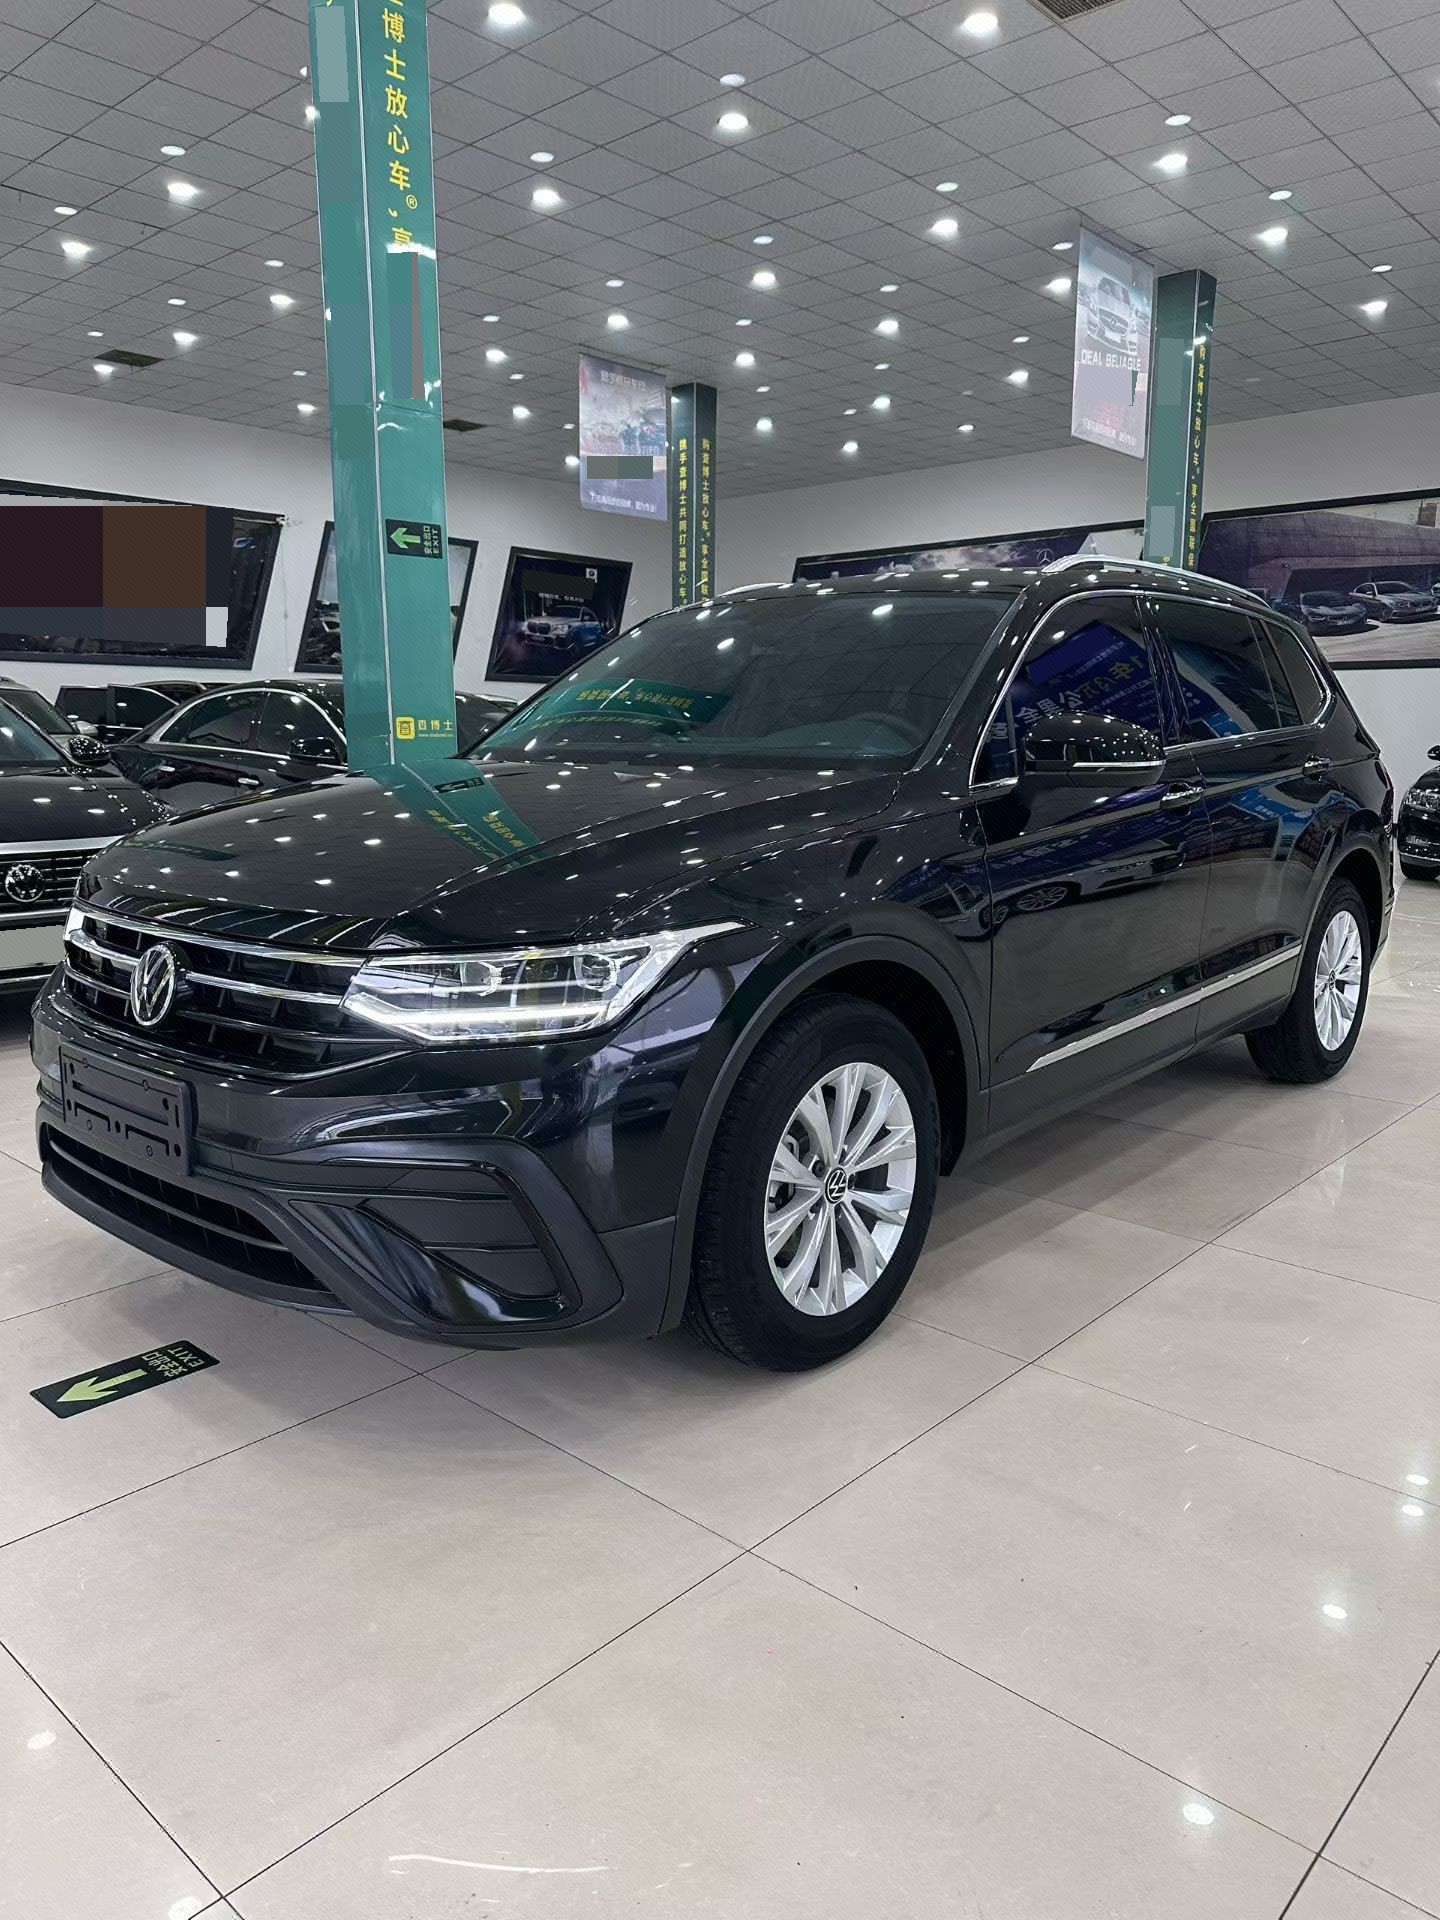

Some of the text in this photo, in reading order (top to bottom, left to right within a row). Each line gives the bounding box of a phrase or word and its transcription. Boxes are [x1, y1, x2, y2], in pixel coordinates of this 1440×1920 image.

[1081, 349, 1103, 366] DEAL
[423, 525, 433, 555] 安全出口
[431, 528, 440, 555] EXIT
[141, 1351, 189, 1378] 安全出口
[167, 1347, 206, 1368] EXIT
